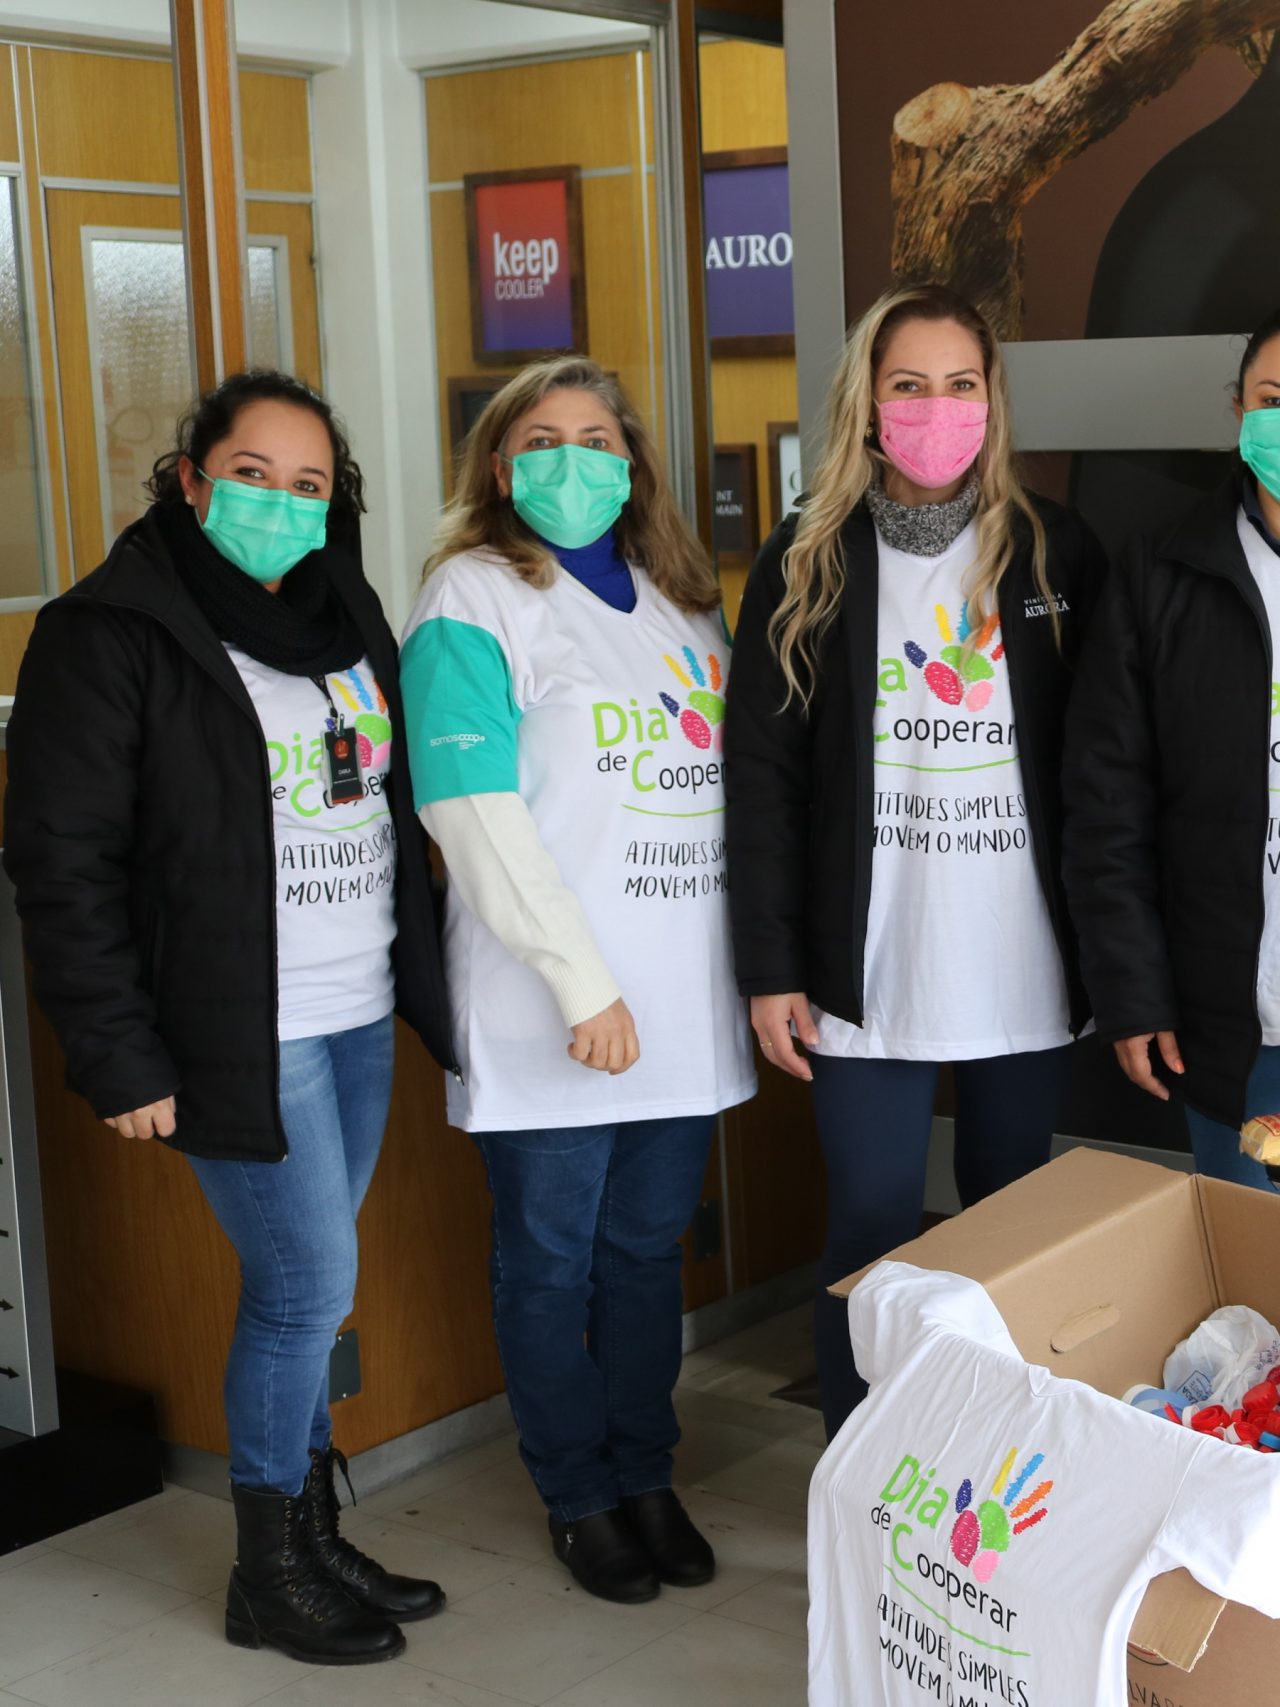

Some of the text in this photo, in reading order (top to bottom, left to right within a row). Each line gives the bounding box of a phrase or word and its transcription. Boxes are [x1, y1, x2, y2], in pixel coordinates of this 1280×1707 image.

[493, 231, 559, 285] keep
[705, 232, 793, 270] AURO
[495, 279, 544, 300] COOLER
[592, 698, 669, 748] Dia
[597, 749, 727, 795] de Cooper
[937, 831, 950, 854] O
[957, 827, 1026, 854] MUNDO
[285, 875, 361, 906] MOVEM
[624, 874, 696, 899] MOVEM
[701, 873, 710, 895] O
[879, 1454, 949, 1529] Dia
[870, 1502, 1017, 1633] de Cooperar
